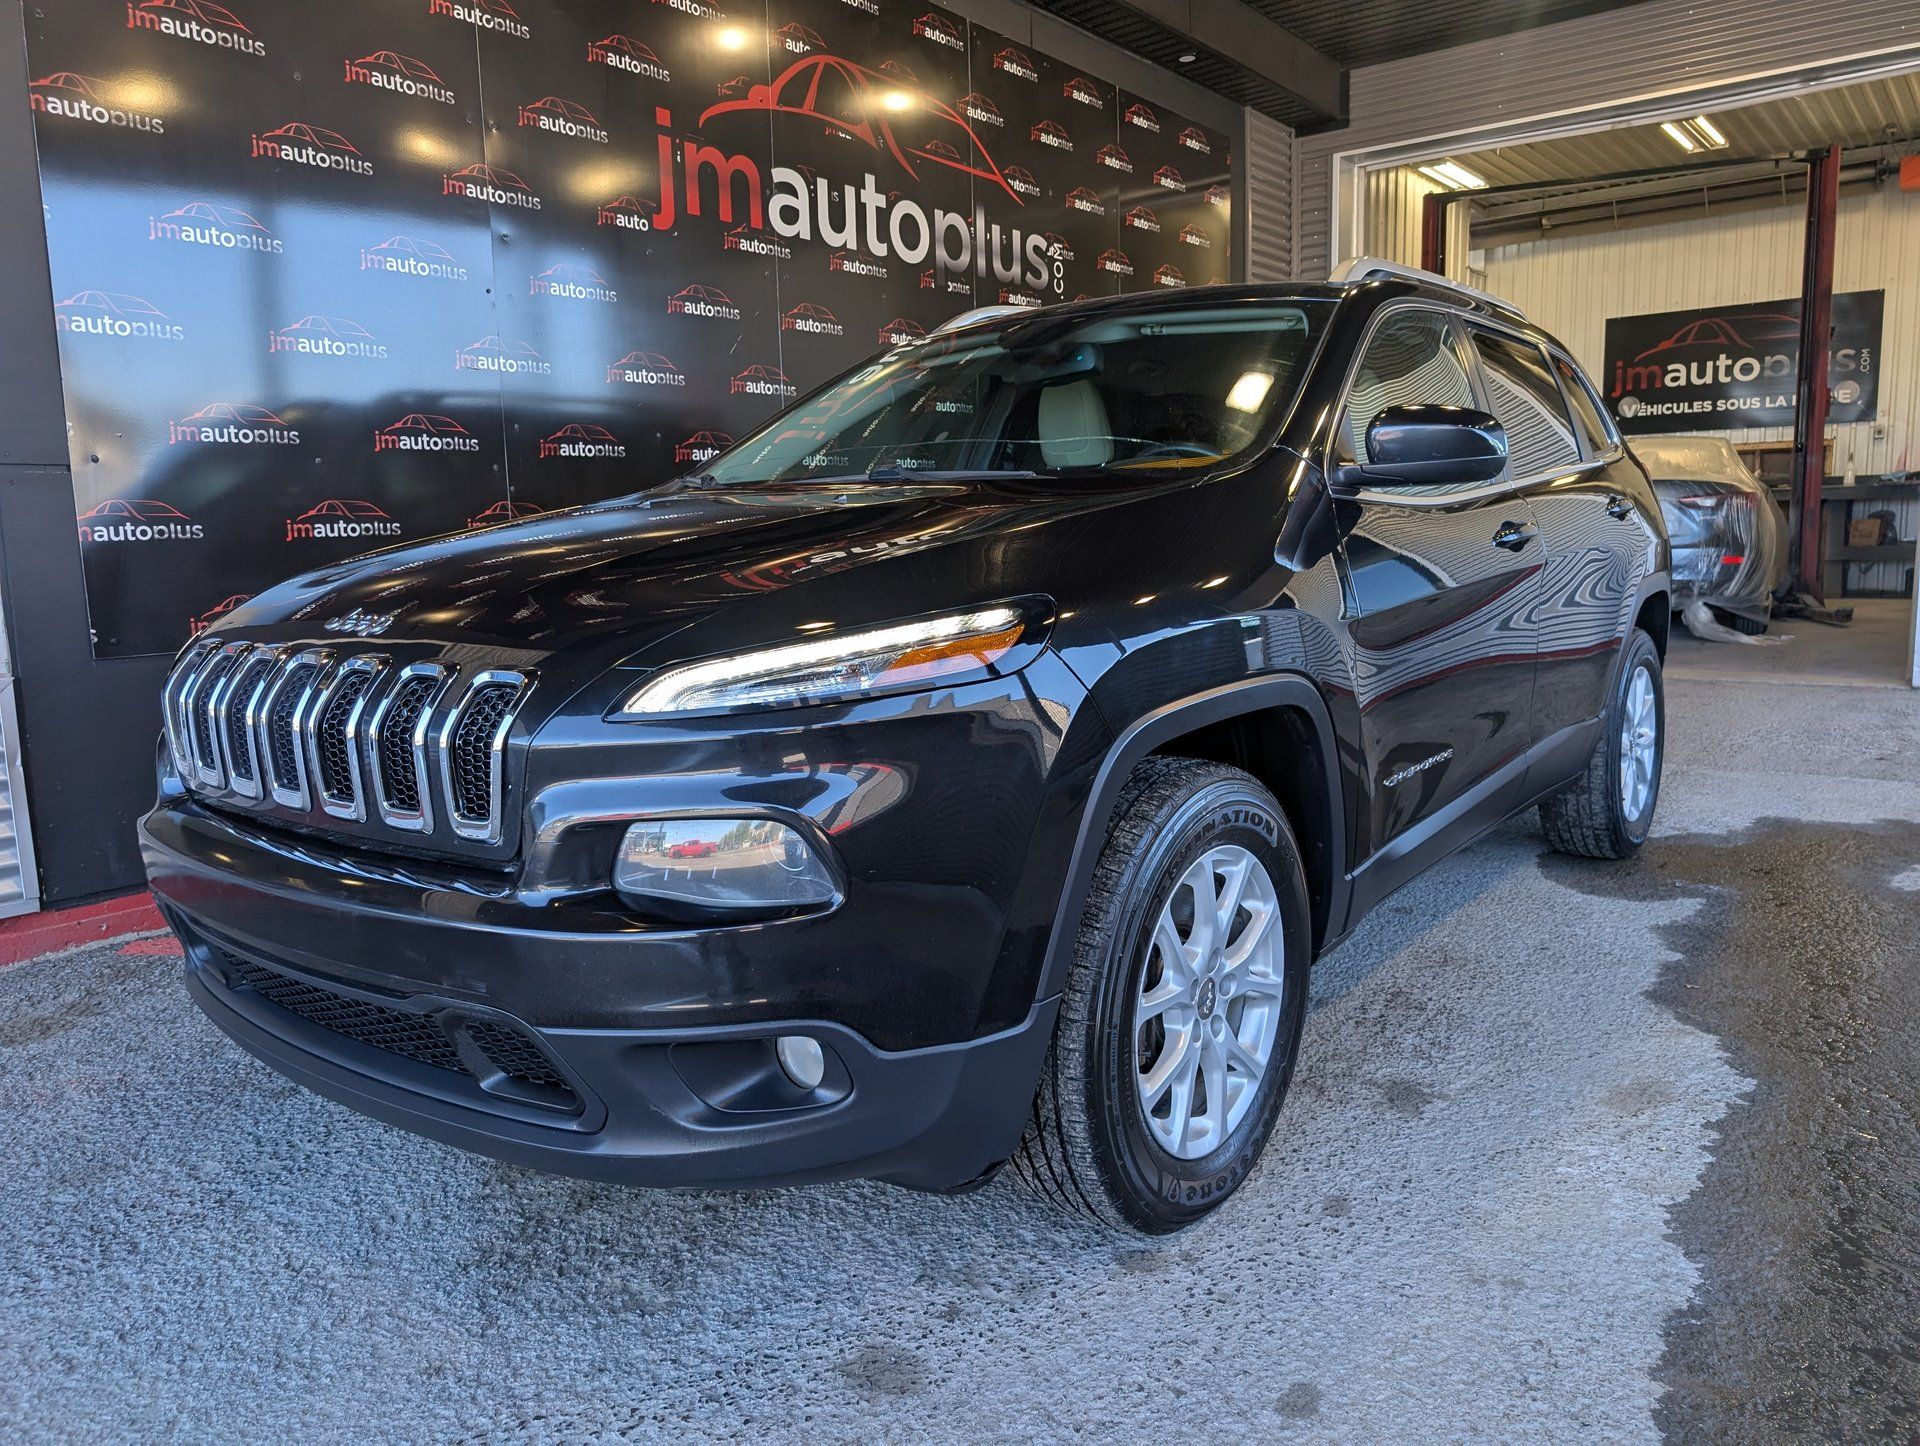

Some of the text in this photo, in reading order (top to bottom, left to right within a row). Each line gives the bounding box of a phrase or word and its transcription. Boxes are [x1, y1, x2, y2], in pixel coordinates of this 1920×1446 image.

[126, 5, 266, 57] jmautoplus
[913, 19, 964, 52] jmautoplus
[588, 41, 670, 83] jmautoplus
[993, 53, 1038, 83] jmautoplus
[344, 60, 455, 105] jmautoplus
[1064, 83, 1103, 110] jmautoplus
[30, 92, 164, 135] mautoplus
[518, 106, 608, 144] jmautoplus
[956, 100, 1004, 127] jmautoplus
[1125, 109, 1160, 133] jmautoplus
[1031, 127, 1073, 151] jmautoplus
[251, 134, 374, 176] jmautoplus
[1096, 150, 1133, 173] jmautoplus
[443, 174, 541, 211] jmautoplus
[652, 106, 1049, 290] jmautoplus
[1066, 194, 1105, 216] jmautoplus
[149, 216, 284, 254] jmautoplus
[1126, 213, 1160, 232] jmautoplus
[724, 232, 791, 259] jmautoplus
[360, 249, 468, 281] jmautoplus
[830, 255, 887, 279] jmautoplus
[1098, 257, 1133, 275] jmautoplus
[530, 276, 617, 303] jmautoplus
[667, 296, 740, 321] jmautoplus
[55, 313, 184, 341] mautoplus
[782, 314, 843, 336] jmautoplus
[269, 331, 388, 359] jmautoplus
[455, 350, 551, 375] jmautoplus
[606, 366, 685, 387] jmautoplus
[731, 377, 797, 397] jmautoplus
[1622, 400, 1712, 418] VÉHICULES
[1716, 397, 1761, 412] SOUS
[1765, 394, 1788, 408] LA
[169, 421, 300, 445] jmautoplus
[374, 431, 479, 453] jmautoplus
[540, 439, 625, 459] jmautoplus
[79, 522, 204, 543] mautoplus
[286, 519, 401, 542] jmautoplus
